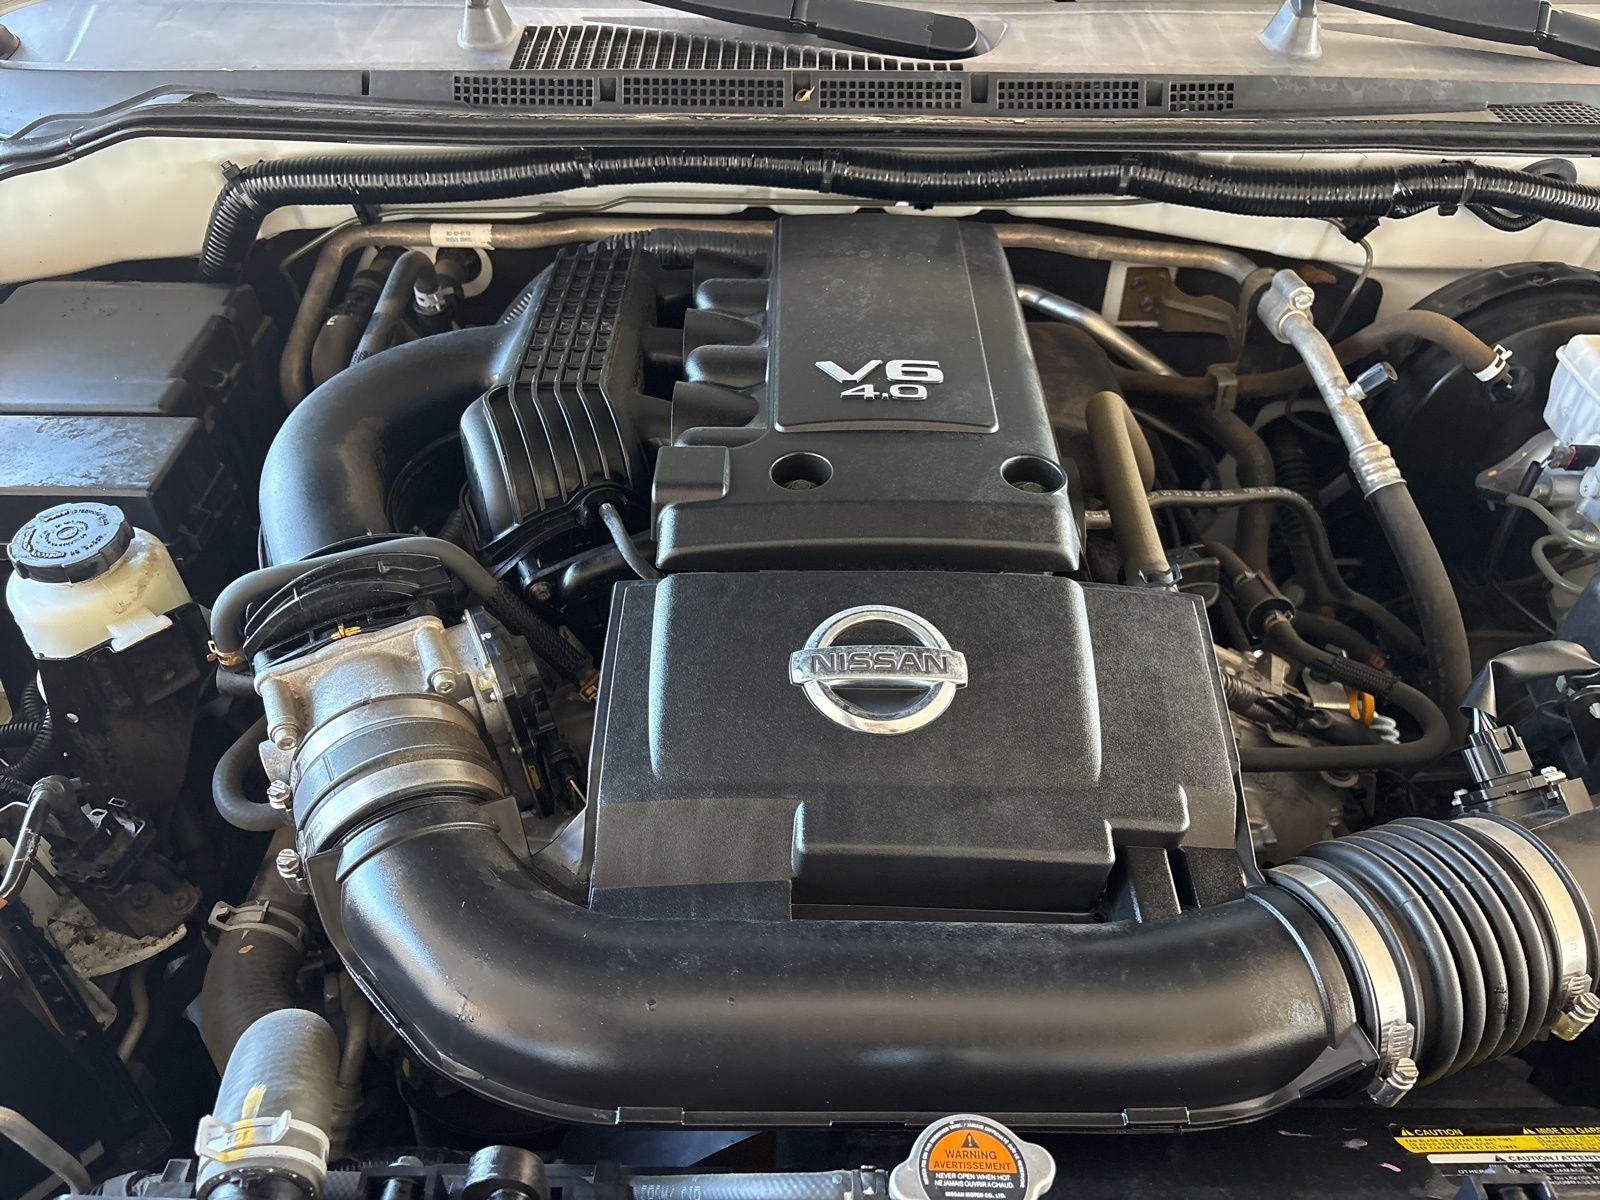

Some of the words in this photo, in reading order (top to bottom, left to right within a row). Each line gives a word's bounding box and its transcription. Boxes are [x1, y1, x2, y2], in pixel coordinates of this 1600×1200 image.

[815, 359, 944, 383] V6
[840, 384, 928, 400] 4.0
[811, 651, 949, 673] NISSAN
[1414, 1128, 1464, 1136] CAUTION
[944, 1149, 997, 1160] WARNING
[934, 1160, 1011, 1171] AVERTISSEMENT
